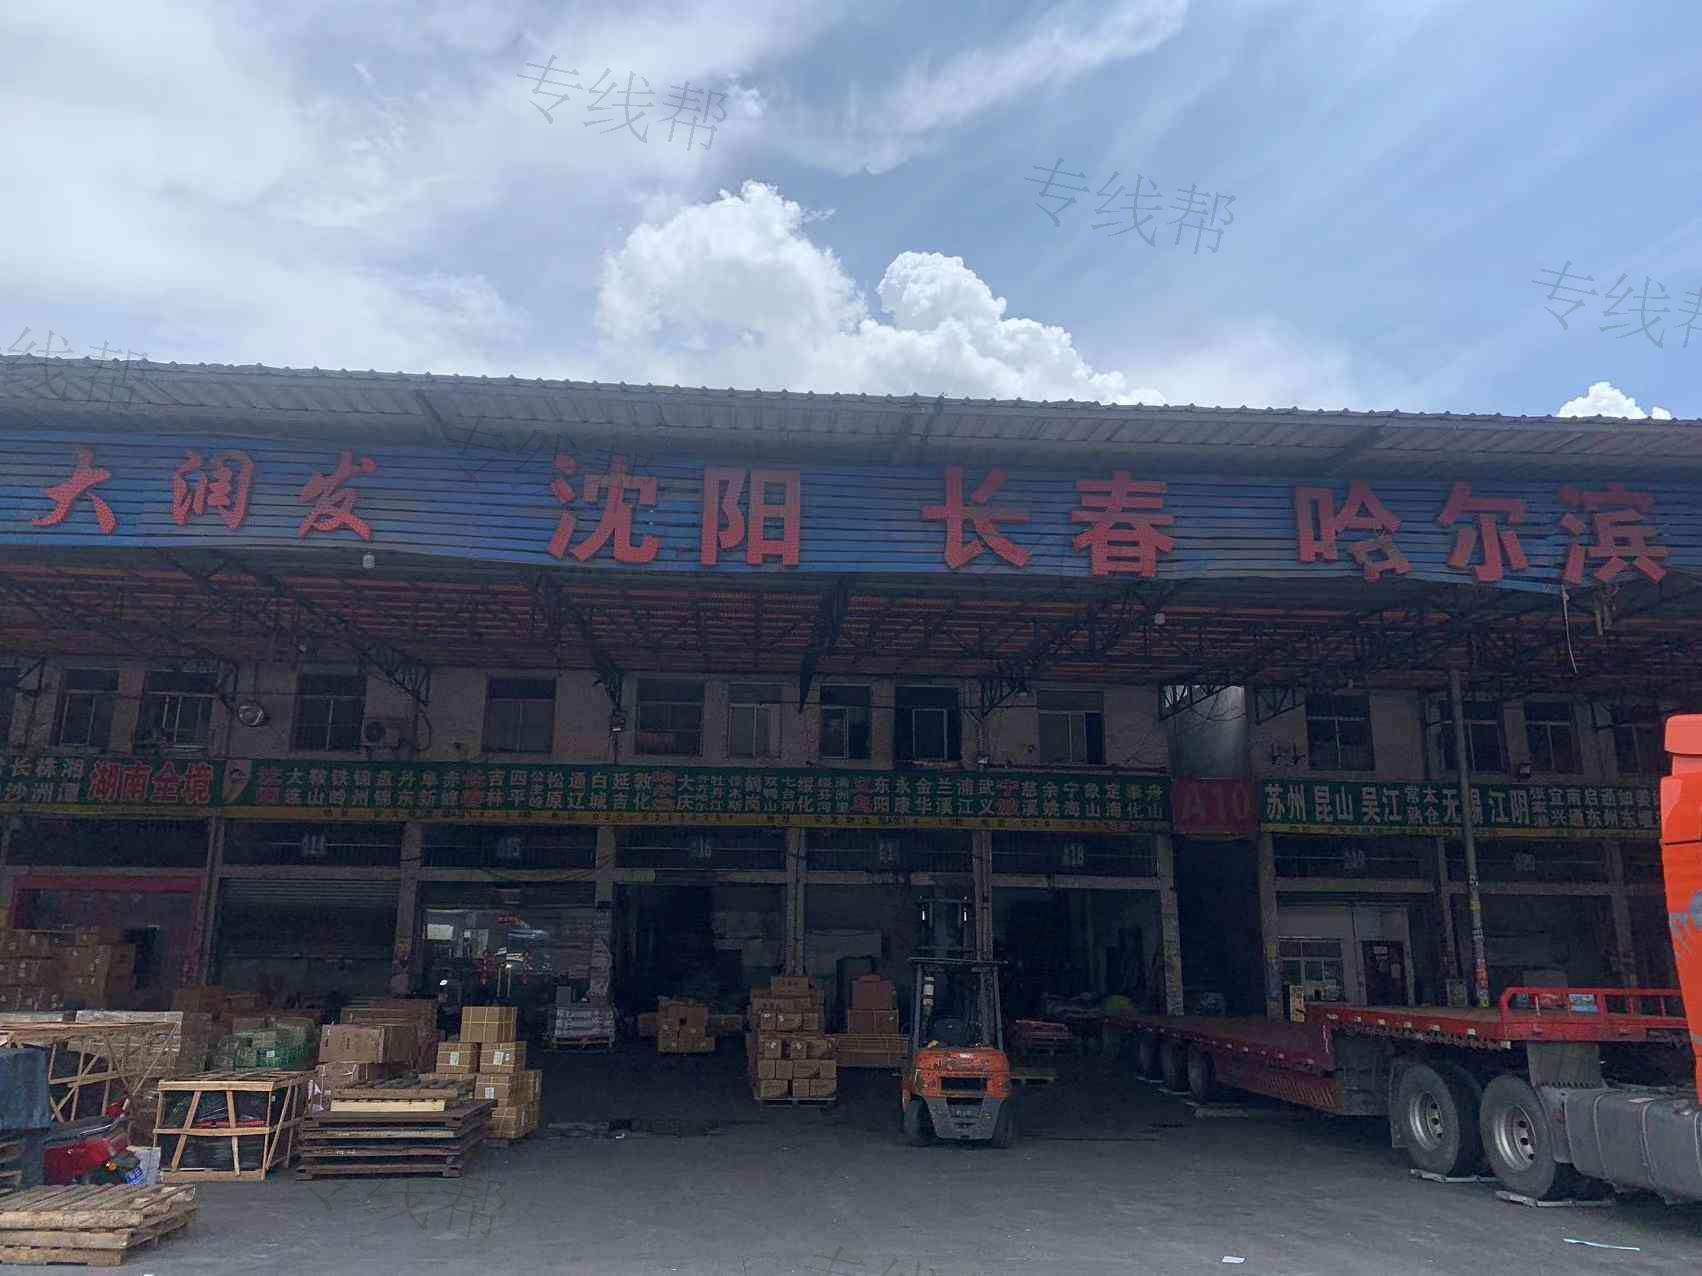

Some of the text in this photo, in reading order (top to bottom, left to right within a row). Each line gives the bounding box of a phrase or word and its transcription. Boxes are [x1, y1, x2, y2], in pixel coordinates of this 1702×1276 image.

[32, 446, 1669, 586] 大润发 沈阳 长春 哈尔滨
